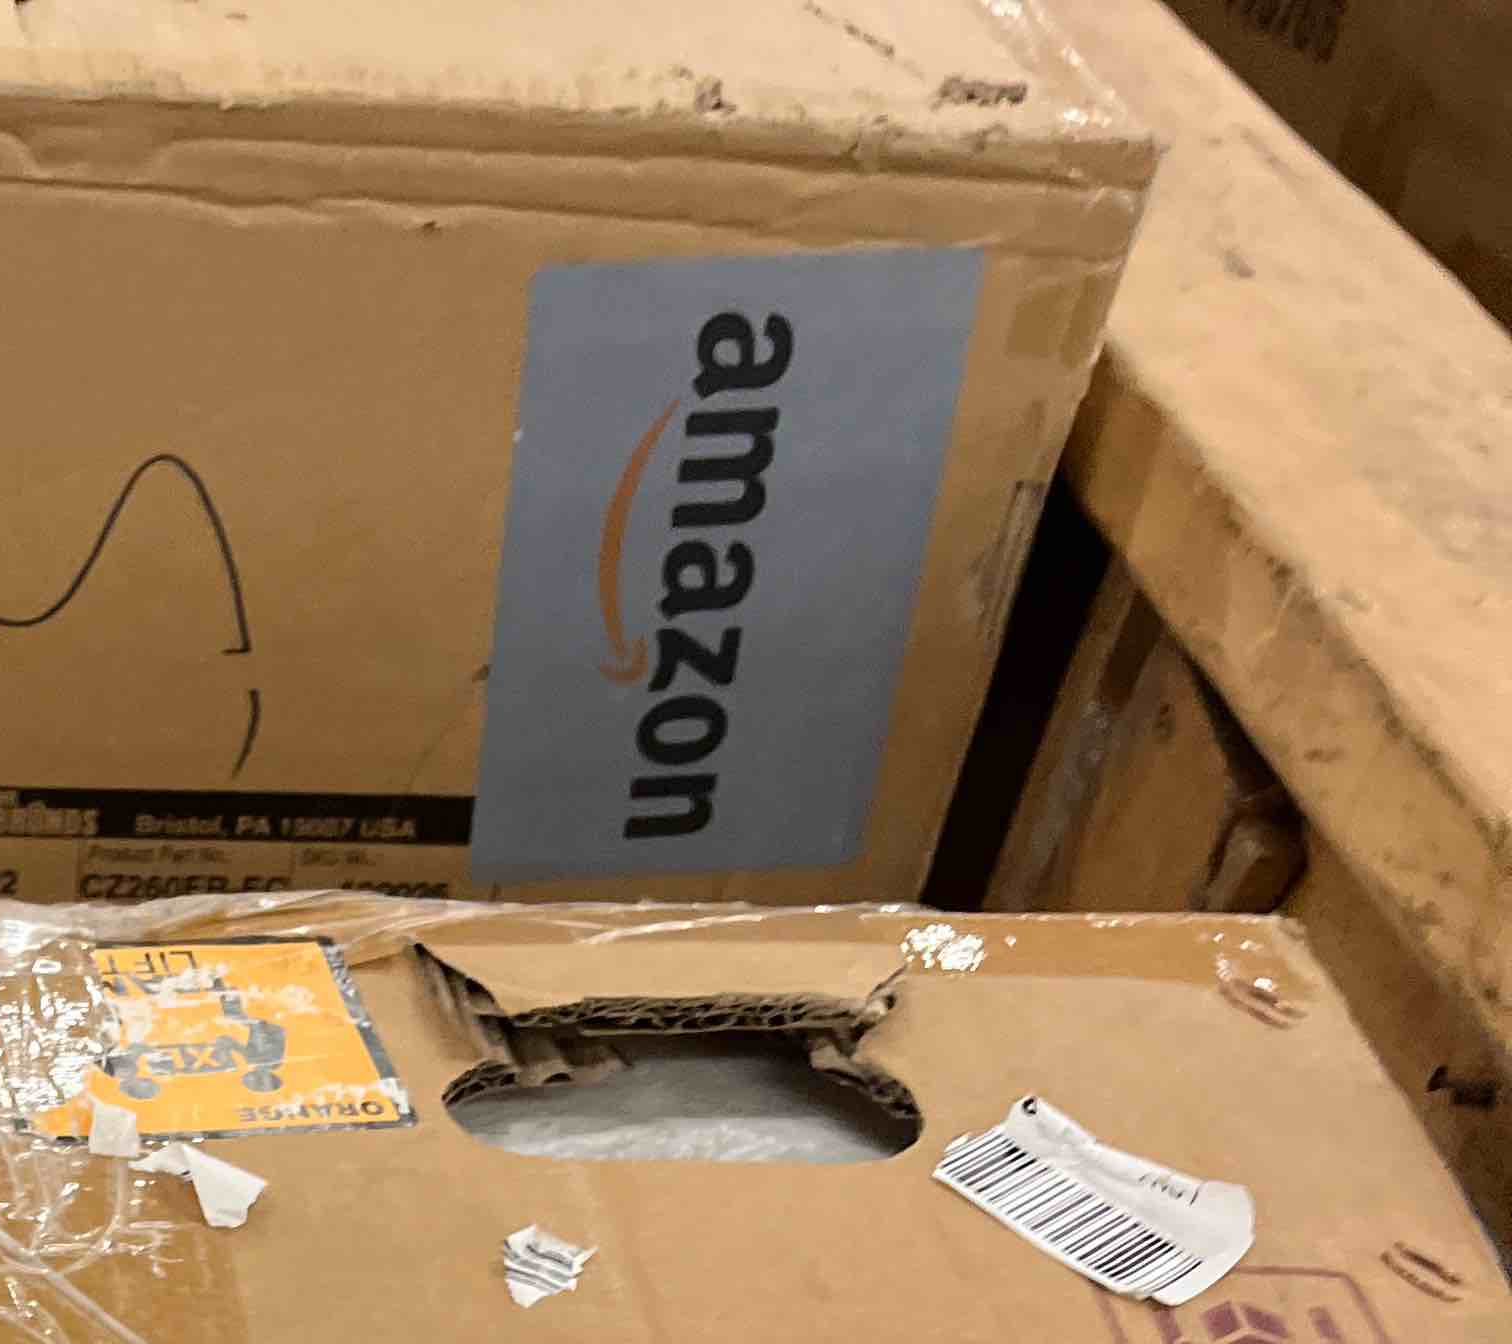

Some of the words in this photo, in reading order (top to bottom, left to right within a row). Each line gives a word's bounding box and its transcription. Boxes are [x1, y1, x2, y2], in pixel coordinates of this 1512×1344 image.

[623, 311, 794, 840] amazon
[235, 815, 270, 837] PA
[359, 818, 417, 840] USA
[101, 950, 198, 976] LIFT
[239, 1099, 385, 1122] ORANGE
